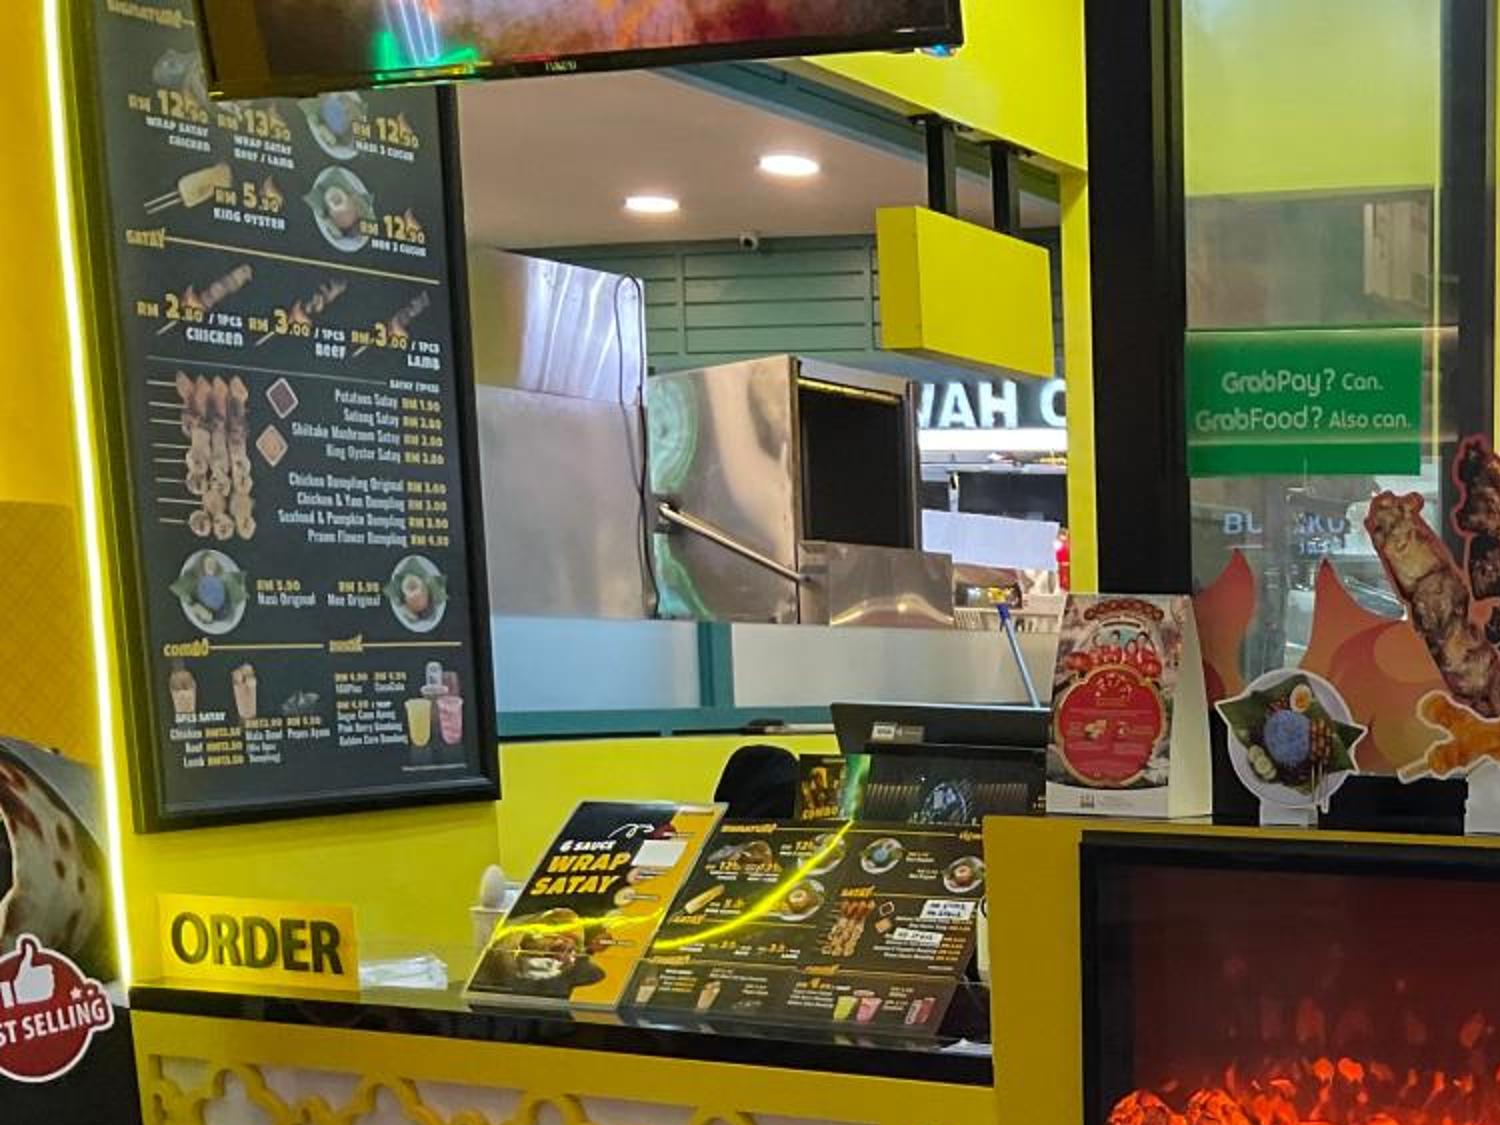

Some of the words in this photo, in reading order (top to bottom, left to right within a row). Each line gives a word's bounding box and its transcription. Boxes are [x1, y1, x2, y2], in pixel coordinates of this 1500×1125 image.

[213, 207, 241, 223] KING
[243, 213, 286, 230] OYSTER
[186, 326, 244, 347] CHICKEN
[407, 353, 441, 371] LAMB
[1221, 367, 1335, 397] GrabPay?
[1342, 372, 1383, 391] Can.
[1195, 406, 1323, 431] GrabFood?
[1328, 410, 1368, 430] Also
[1372, 411, 1412, 429] can.
[164, 637, 209, 658] combo
[559, 840, 573, 853] 6
[575, 840, 617, 852] SAUCE
[547, 852, 631, 873] WRAP
[529, 875, 621, 896] SATAY
[170, 911, 344, 975] ORDER
[21, 998, 106, 1040] SELLING
